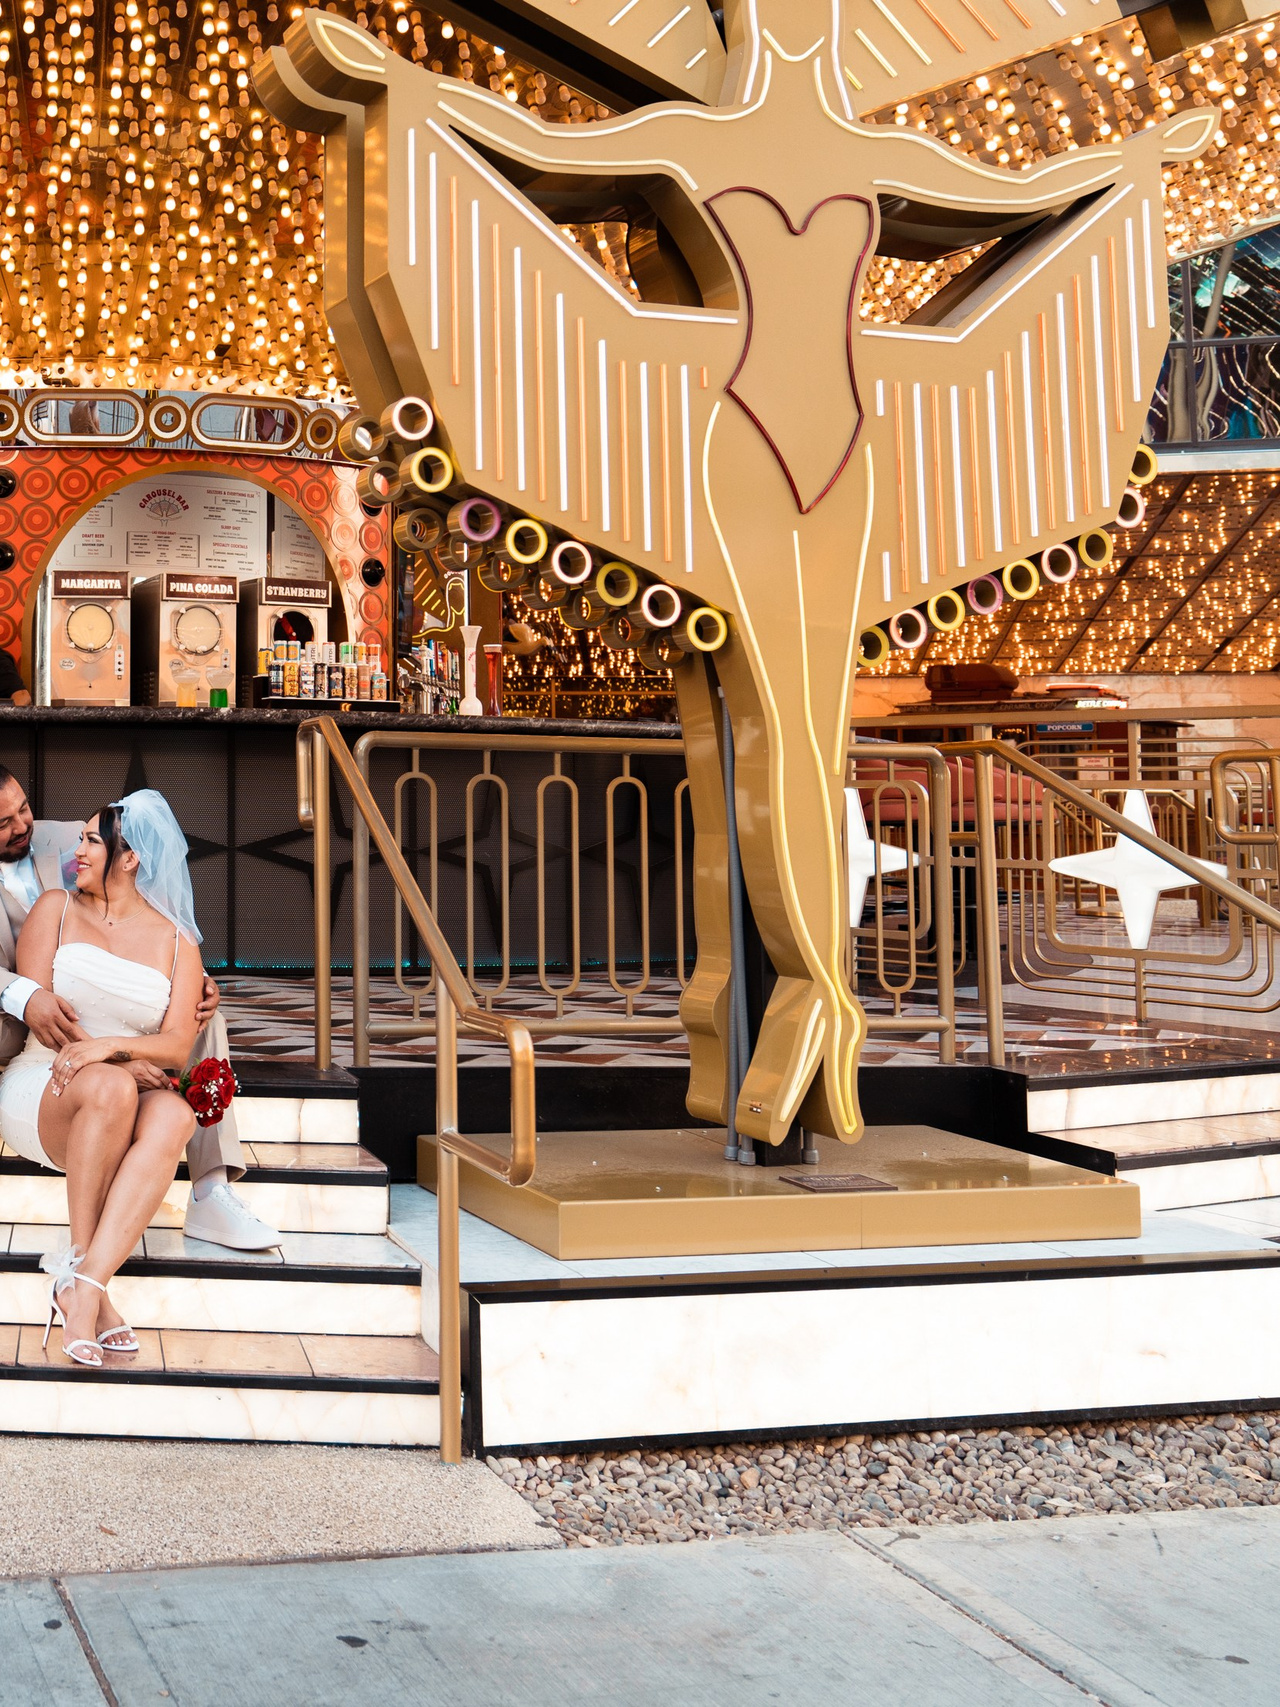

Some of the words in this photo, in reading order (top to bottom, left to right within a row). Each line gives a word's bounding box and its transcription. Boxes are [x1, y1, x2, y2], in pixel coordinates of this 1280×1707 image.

[139, 488, 176, 509] CAROUSEL
[176, 495, 190, 511] BAR
[61, 578, 122, 589] MARGARITA
[170, 582, 195, 593] PINA
[195, 583, 234, 595] COLADA
[266, 585, 327, 599] STRAWBERRY
[1047, 724, 1083, 732] POPCORN
